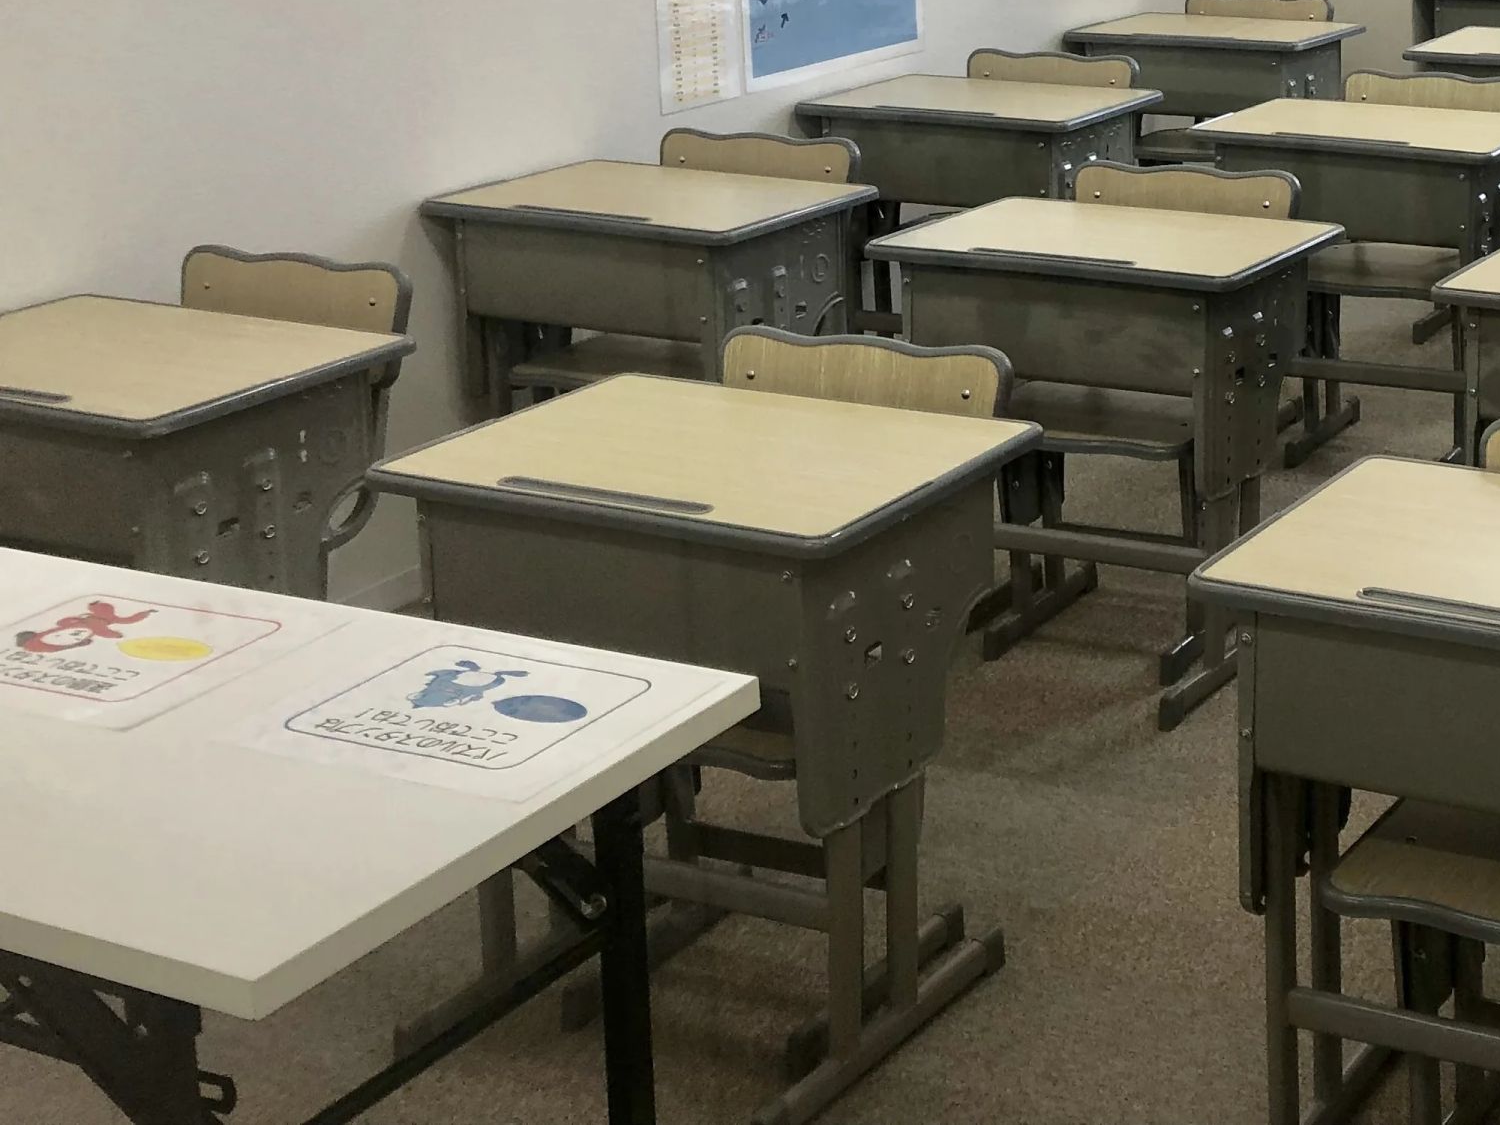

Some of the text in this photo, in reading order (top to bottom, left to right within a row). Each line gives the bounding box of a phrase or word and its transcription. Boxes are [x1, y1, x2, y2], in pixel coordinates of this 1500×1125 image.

[314, 716, 508, 762] パズルのスタンプは
[355, 707, 518, 745] ここでおしてね!
